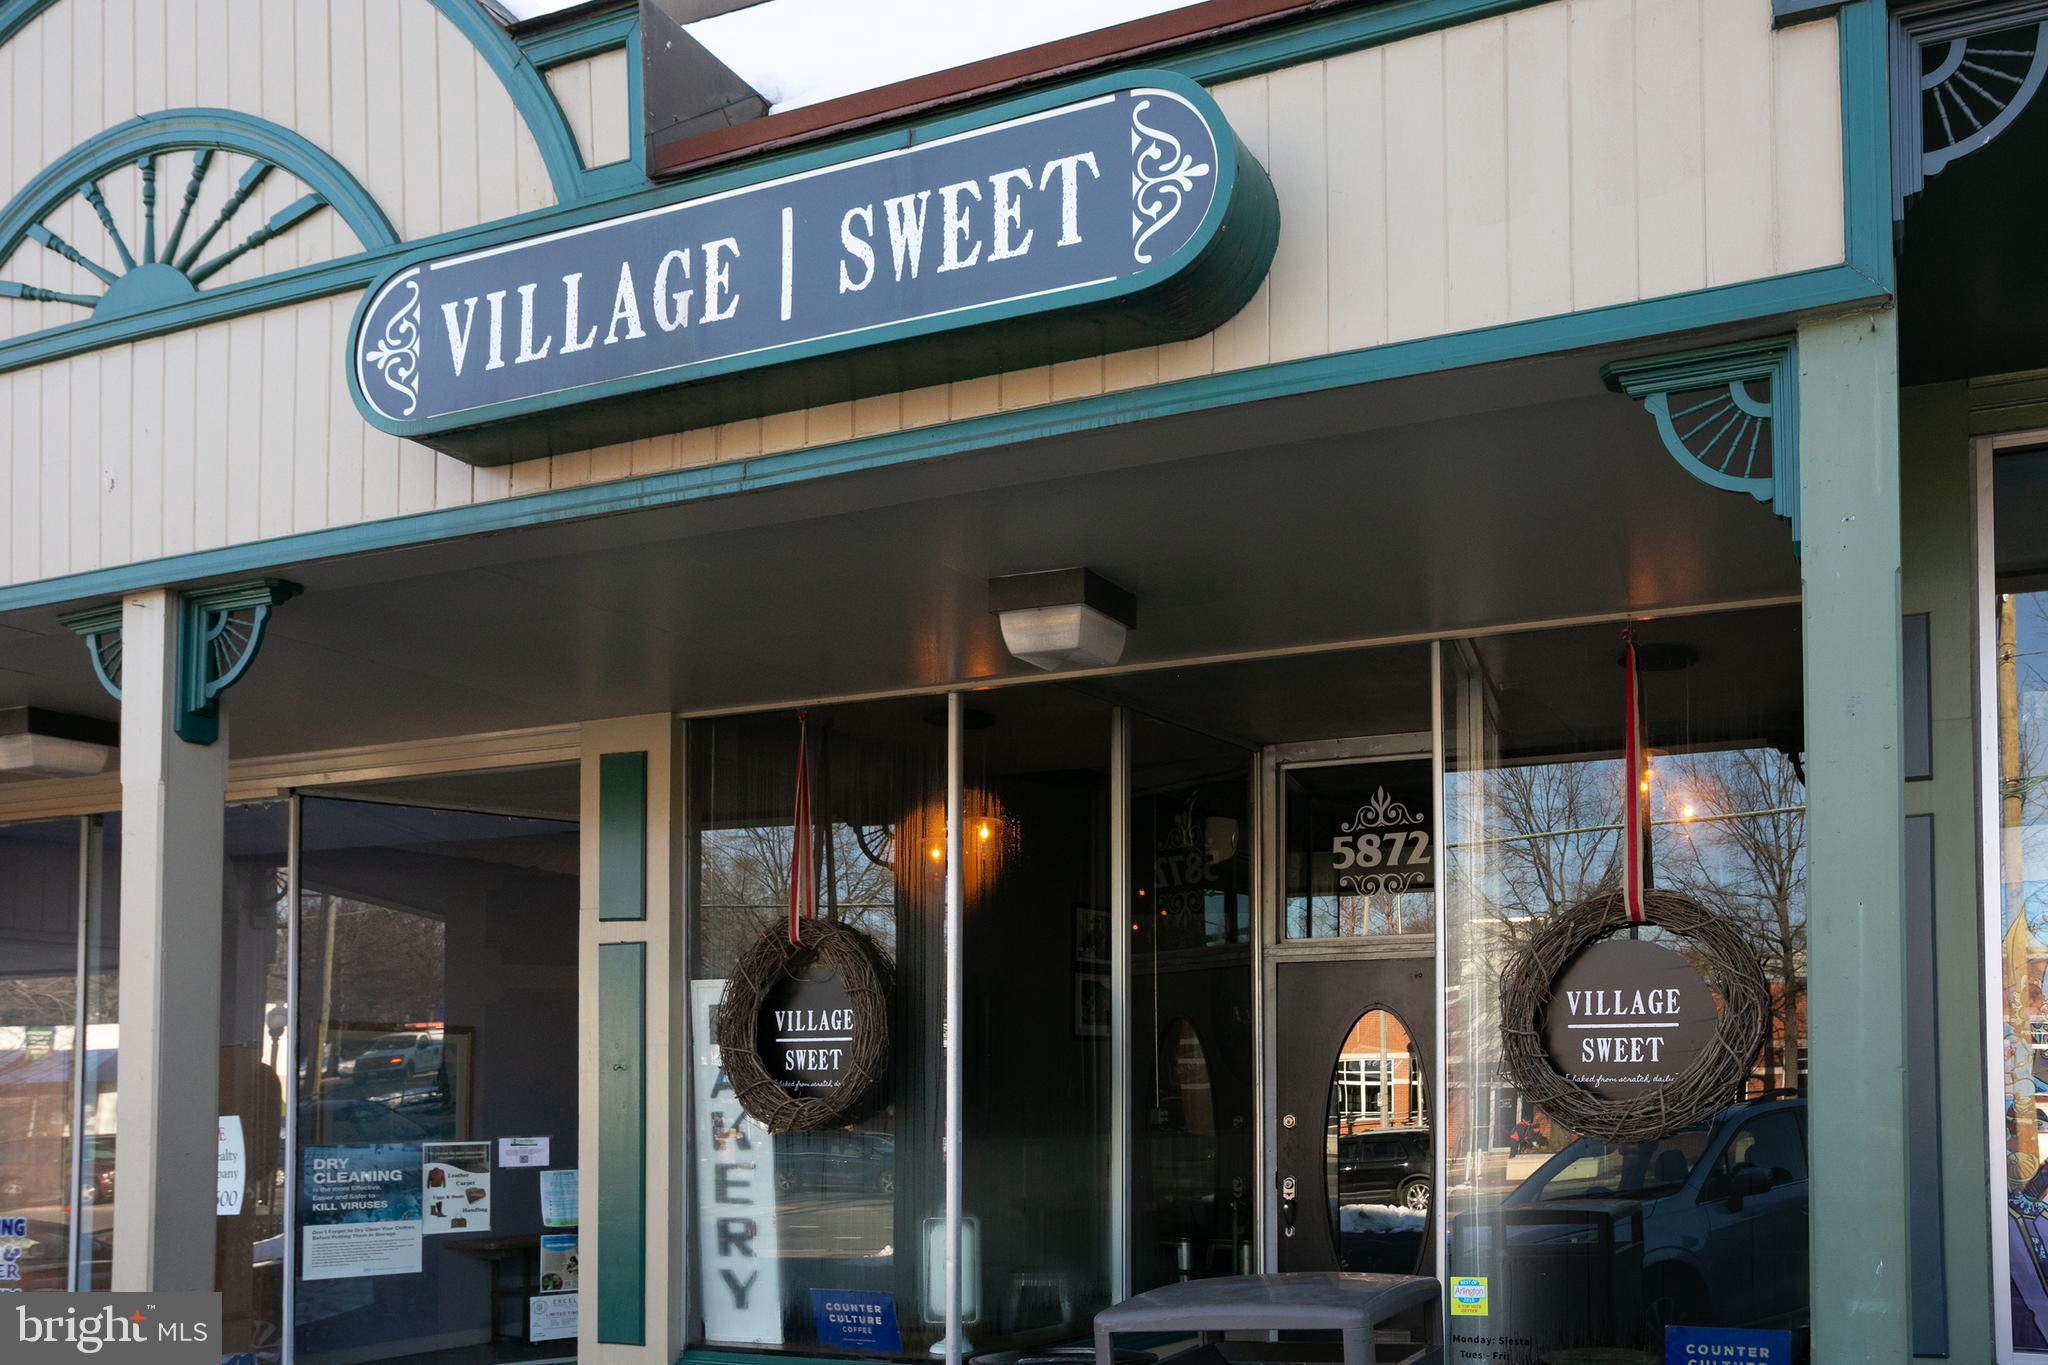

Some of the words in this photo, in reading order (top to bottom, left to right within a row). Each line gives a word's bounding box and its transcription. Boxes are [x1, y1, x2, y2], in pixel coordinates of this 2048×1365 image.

[441, 237, 740, 376] VILLAGE
[840, 152, 1100, 294] SWEET
[1332, 830, 1432, 870] 5872
[1566, 989, 1681, 1016] VILLAGE
[775, 1009, 854, 1032] VILLAGE
[1581, 1037, 1665, 1063] SWEET
[785, 1049, 843, 1071] SWEET
[1594, 1074, 1617, 1088] from
[313, 1158, 349, 1170] DRY
[708, 1004, 758, 1311] AKERY
[313, 1170, 403, 1184] CLEANING
[312, 1202, 338, 1211] KILL
[340, 1200, 388, 1210] VIRUSES
[0, 1217, 25, 1236] NG
[825, 1302, 882, 1314] COUNTER
[828, 1314, 882, 1326] CULTURE
[842, 1326, 872, 1335] COFFEE
[1452, 1335, 1495, 1345] Monday:
[1498, 1336, 1530, 1346] Siesta
[1460, 1350, 1482, 1359] Tues
[1492, 1351, 1510, 1361] Fri:
[1685, 1344, 1770, 1358] COUNTER
